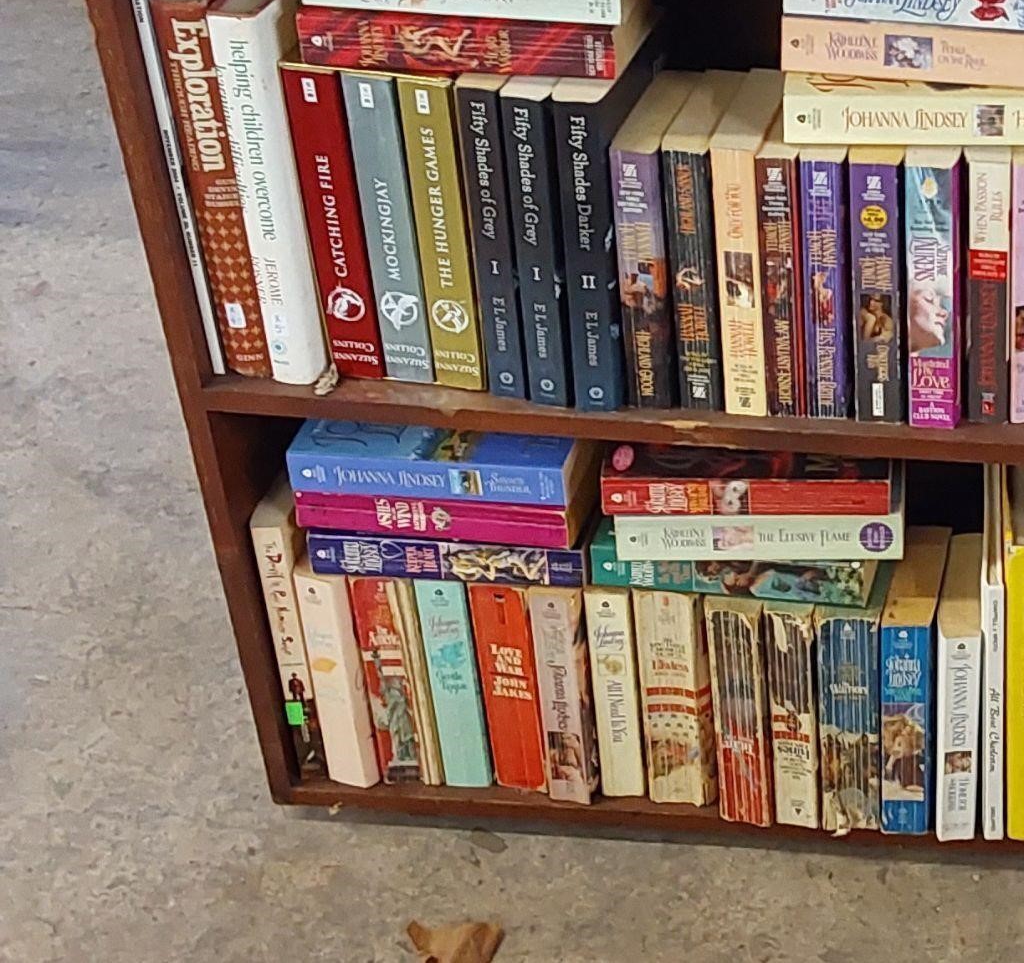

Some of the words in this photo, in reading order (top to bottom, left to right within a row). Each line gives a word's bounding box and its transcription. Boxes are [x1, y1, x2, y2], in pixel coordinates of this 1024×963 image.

[229, 40, 252, 99] helping
[169, 17, 226, 173] Exploration
[240, 102, 268, 168] children
[469, 101, 485, 136] Fifty
[513, 106, 530, 140] Fifty
[568, 115, 586, 150] Fifty
[842, 107, 910, 129] JOHANNA
[914, 108, 969, 129] LINDSEY
[421, 127, 441, 182] GAMES
[473, 136, 492, 186] Shades
[516, 142, 535, 192] Shades
[316, 154, 335, 194] FIRE
[571, 151, 588, 201] Shades
[251, 170, 278, 242] overcome
[479, 187, 493, 204] of
[522, 194, 536, 211] of
[975, 172, 988, 217] PASSION
[990, 190, 1003, 222] RULES
[321, 195, 350, 278] CATCHING
[374, 176, 404, 281] MOCKINGJAY
[429, 187, 451, 254] HUNGER
[481, 205, 498, 239] Grey
[523, 212, 541, 246] Grey
[576, 202, 592, 251] Darker
[973, 218, 986, 244] WHEN
[262, 258, 283, 308] JEROME
[436, 260, 455, 289] THE
[490, 260, 501, 275] I
[532, 266, 542, 281] I
[581, 274, 596, 290] II
[492, 297, 505, 306] E
[493, 307, 505, 315] L
[534, 303, 546, 312] E
[534, 313, 546, 321] L
[585, 311, 599, 321] E
[493, 316, 507, 352] James
[534, 322, 549, 358] James
[585, 322, 599, 330] L
[586, 331, 599, 366] James
[490, 643, 523, 658] LOVE
[495, 654, 522, 667] AND
[492, 676, 528, 687] JOHN
[494, 663, 525, 676] WAR
[491, 686, 533, 701] JAKES
